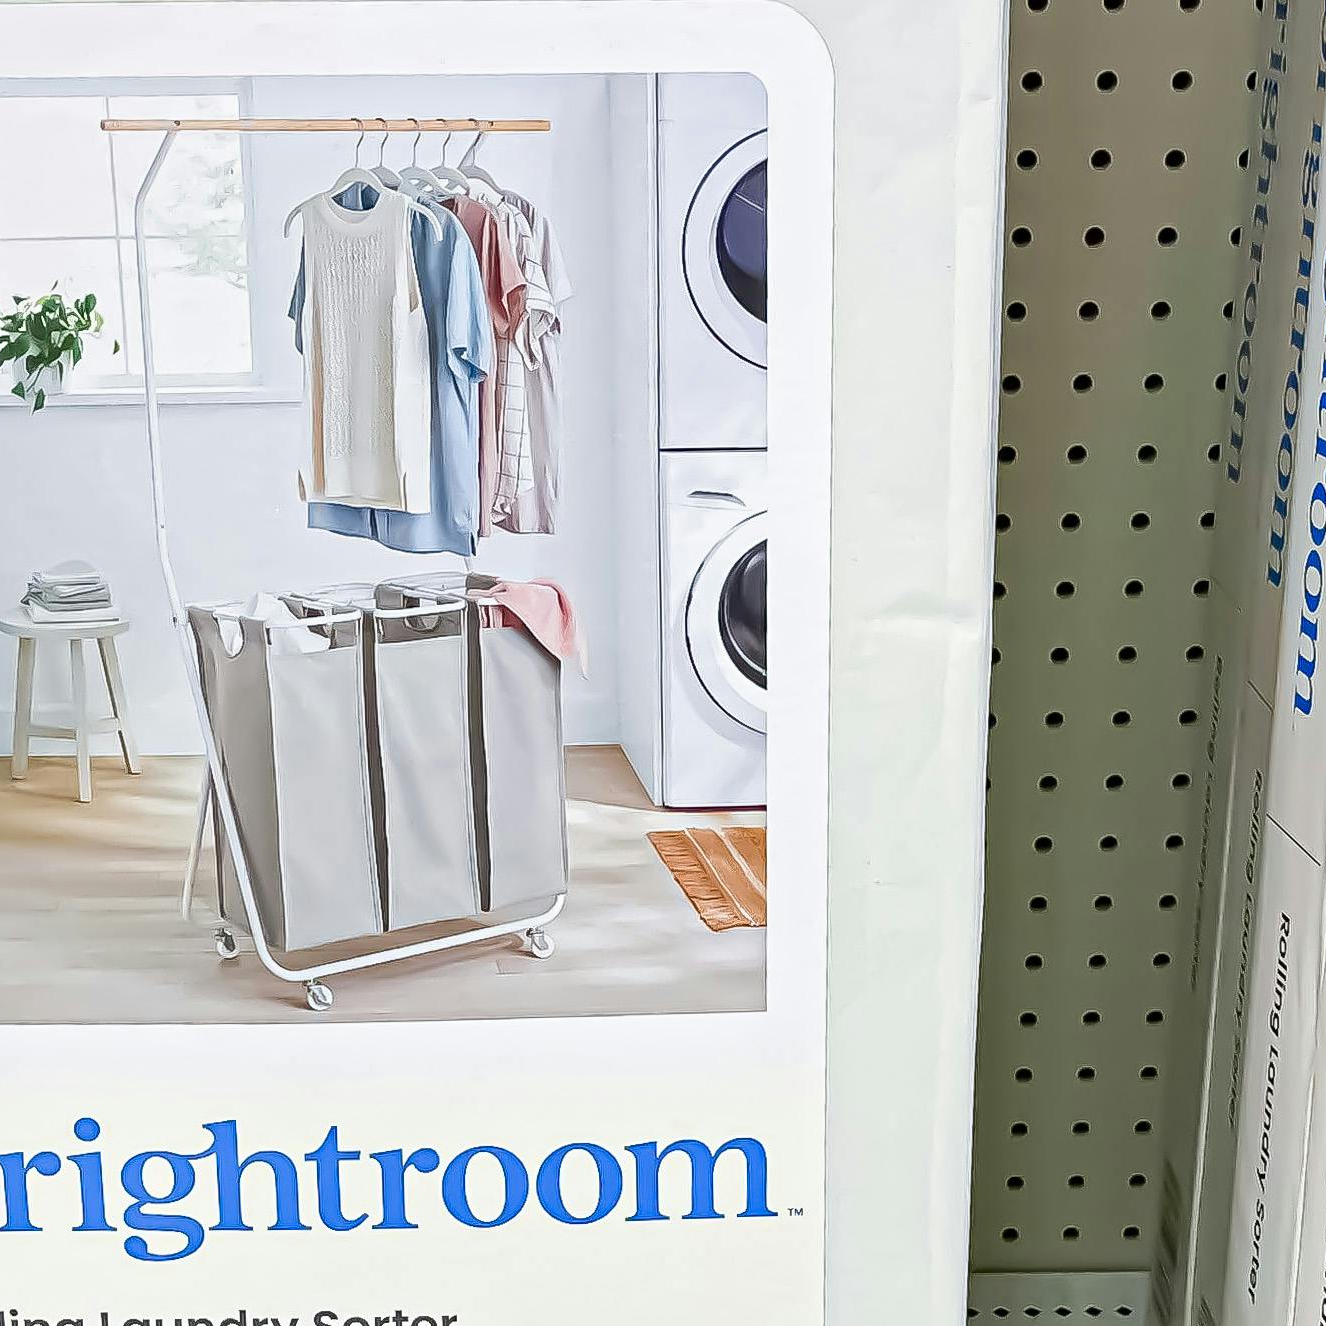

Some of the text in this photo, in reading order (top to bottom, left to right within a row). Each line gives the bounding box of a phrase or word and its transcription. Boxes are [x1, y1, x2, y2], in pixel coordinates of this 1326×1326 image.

[1248, 912, 1290, 1305] Rolling Laundry Sorter
